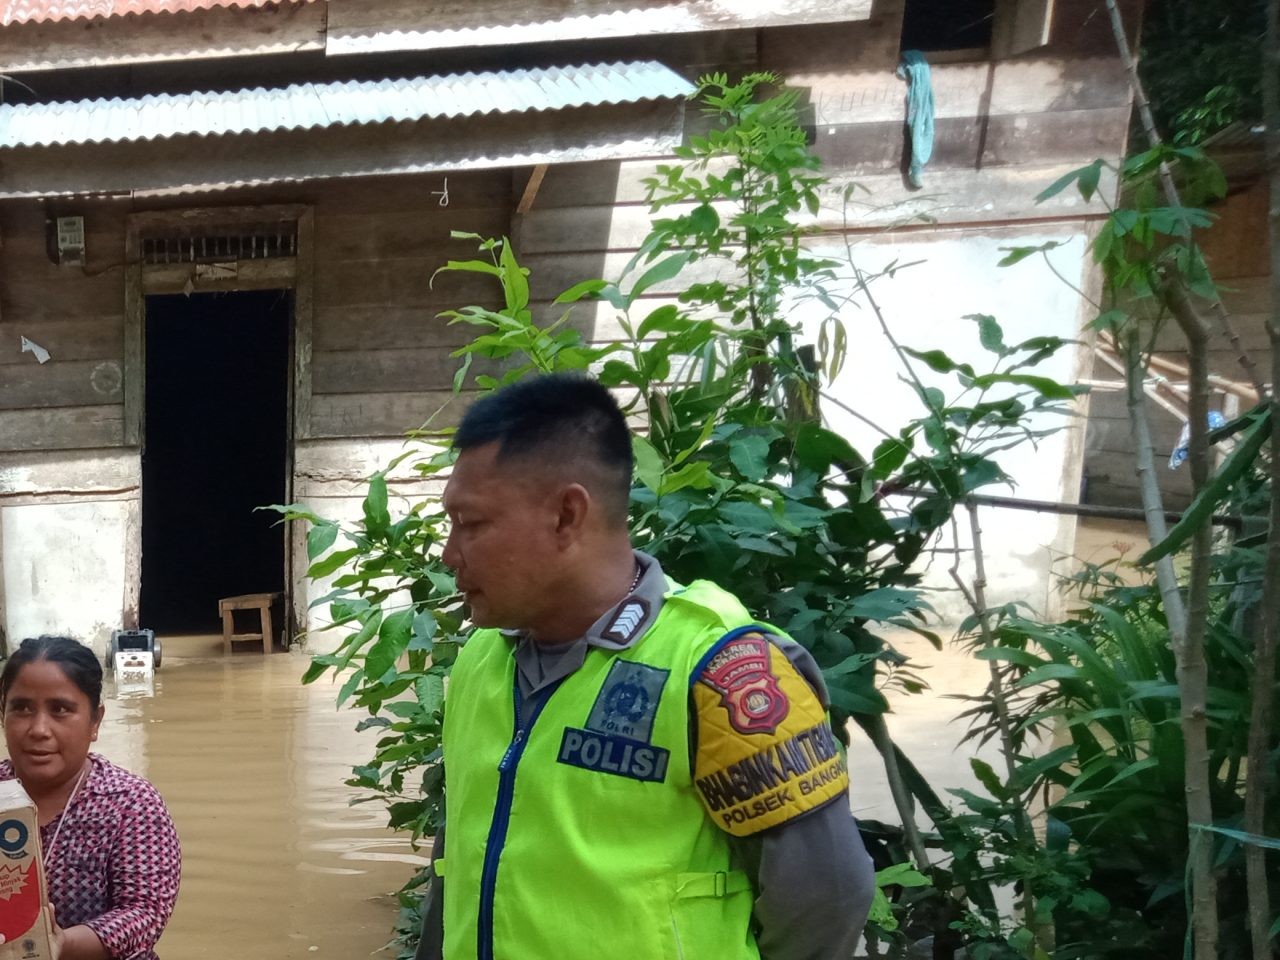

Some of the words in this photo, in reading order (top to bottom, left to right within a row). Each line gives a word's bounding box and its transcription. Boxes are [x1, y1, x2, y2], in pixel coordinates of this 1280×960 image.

[723, 662, 763, 684] JAMBI
[600, 719, 634, 735] POLRI
[561, 733, 666, 778] POLISI
[722, 788, 794, 828] POLSEK
